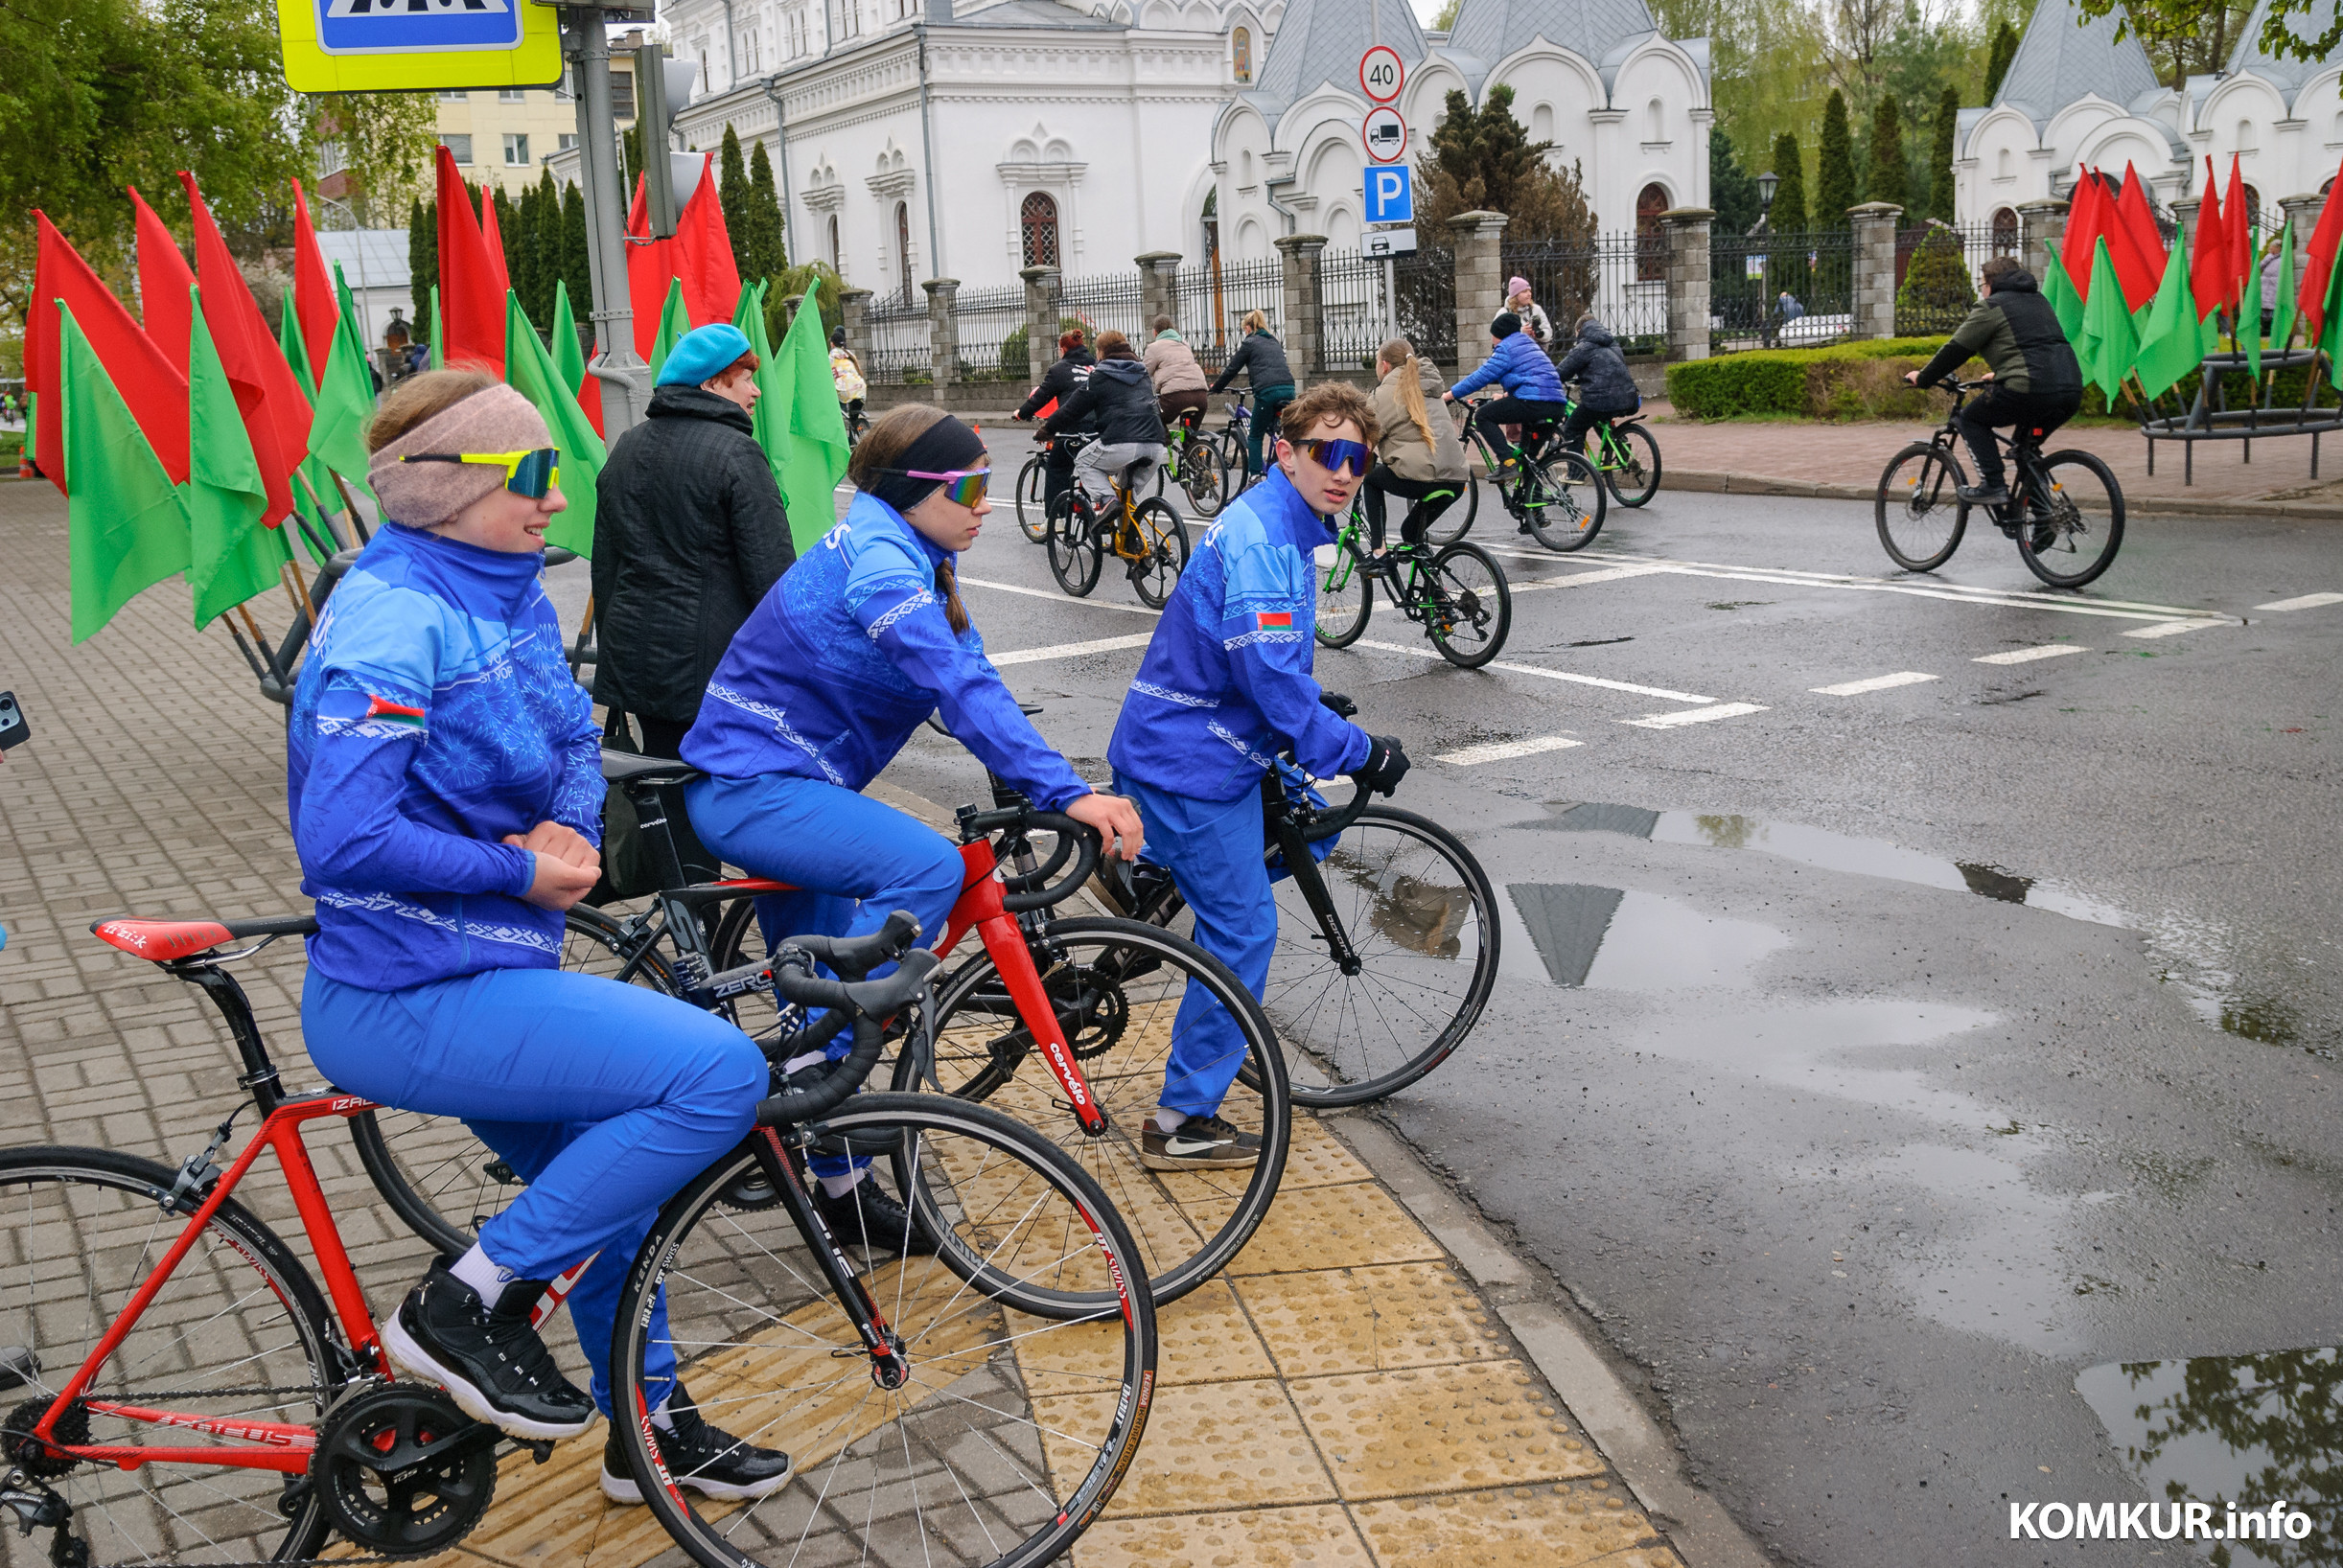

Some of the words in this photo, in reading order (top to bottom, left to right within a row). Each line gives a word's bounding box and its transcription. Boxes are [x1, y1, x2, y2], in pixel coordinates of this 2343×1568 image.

[1369, 64, 1394, 86] 40
[1376, 172, 1403, 217] P
[1050, 1042, 1086, 1105] cervélo
[634, 1234, 662, 1293] KENDA
[655, 1268, 665, 1285] DT
[661, 1241, 680, 1269] SWISS
[1093, 1232, 1113, 1255] DT
[1108, 1257, 1127, 1300] SWISS
[1140, 1372, 1152, 1407] KENDA
[640, 1415, 660, 1460] SWISS
[654, 1462, 674, 1487] DT
